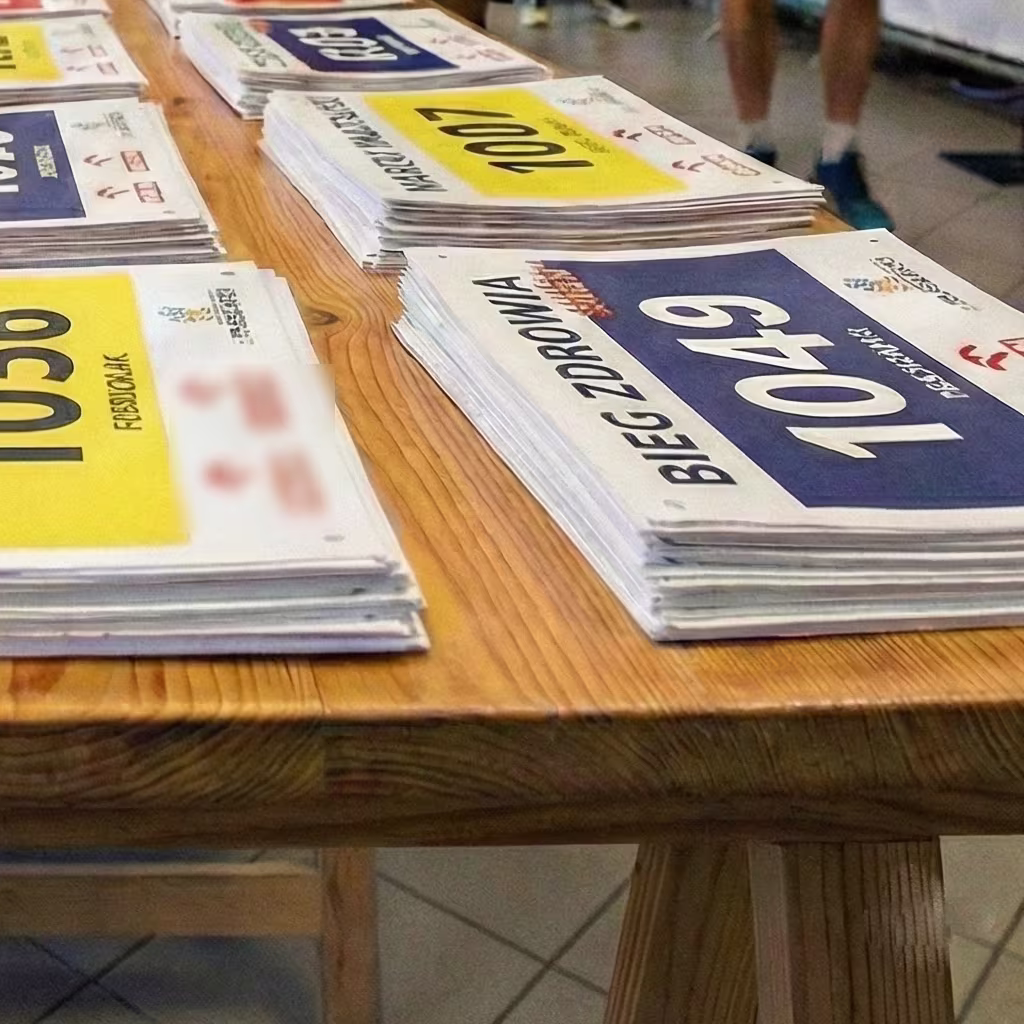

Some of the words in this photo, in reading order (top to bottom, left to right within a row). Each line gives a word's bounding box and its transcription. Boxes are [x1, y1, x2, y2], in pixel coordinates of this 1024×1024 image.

[413, 107, 595, 175] 1007
[471, 275, 648, 402] ZDROWIA
[637, 294, 964, 459] 1049
[600, 410, 737, 485] BIEG
